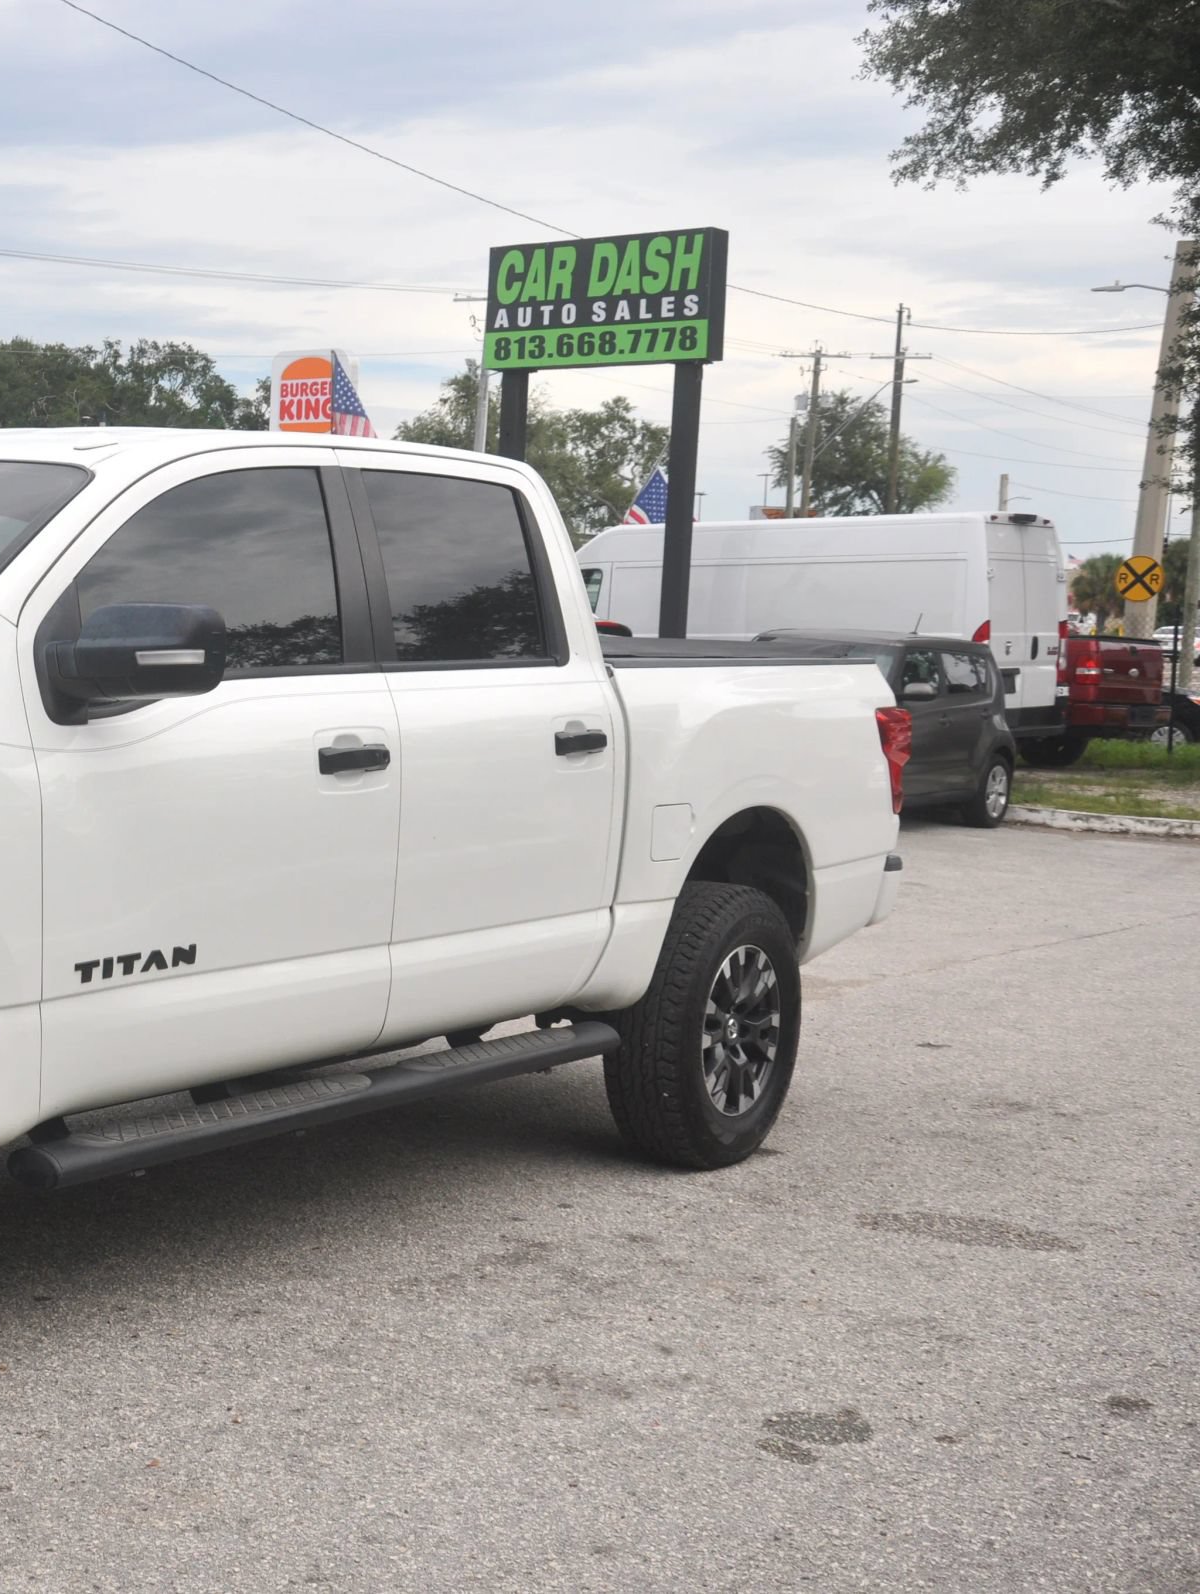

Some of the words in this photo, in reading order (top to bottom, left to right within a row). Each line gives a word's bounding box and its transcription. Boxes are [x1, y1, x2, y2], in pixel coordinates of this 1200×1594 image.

[496, 246, 577, 305] CAR
[587, 234, 704, 298] DASH
[494, 303, 577, 329] AUTO
[592, 294, 700, 323] SALES
[494, 326, 698, 361] 813.668.7778
[1119, 573, 1128, 584] R
[1150, 573, 1160, 585] R
[74, 943, 197, 984] TITAN
